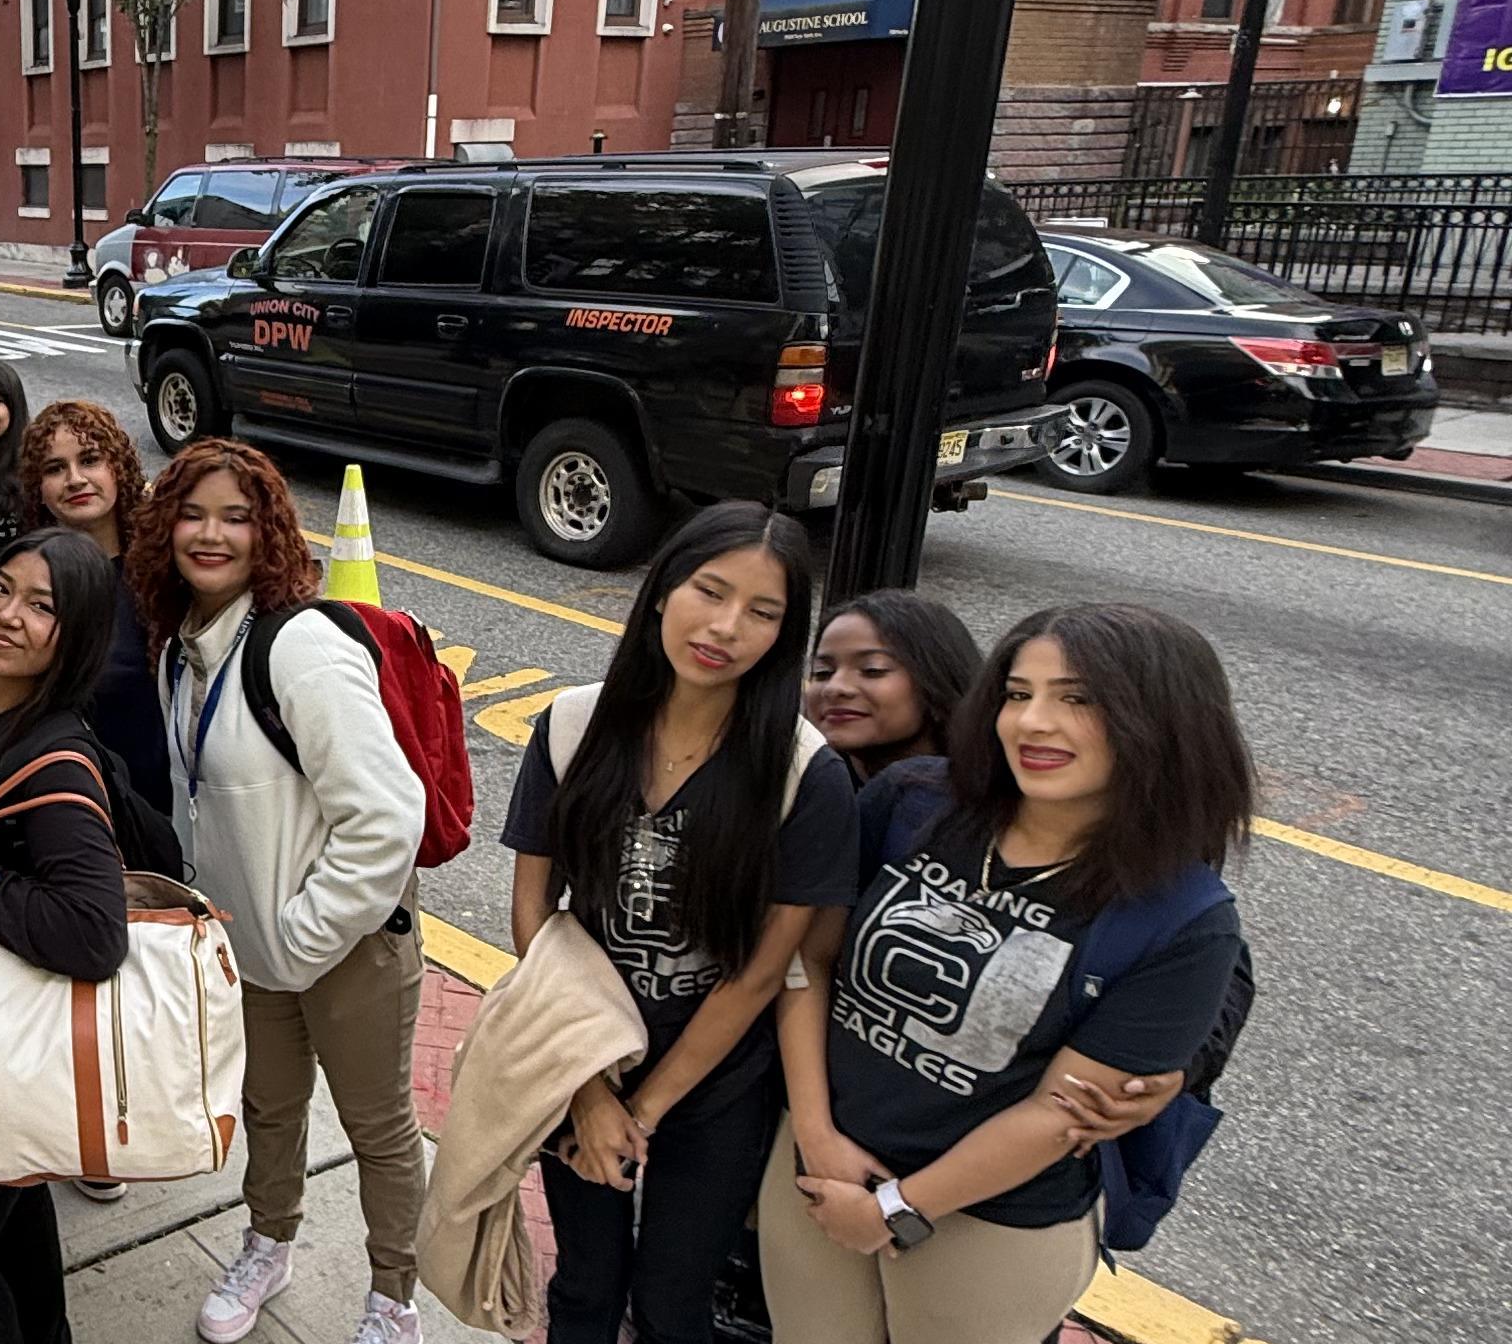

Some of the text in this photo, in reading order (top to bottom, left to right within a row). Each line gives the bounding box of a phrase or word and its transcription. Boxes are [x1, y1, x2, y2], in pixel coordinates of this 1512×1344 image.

[759, 11, 869, 34] AUGUSTINE SCHOOL
[249, 299, 322, 323] UNION CITY
[565, 308, 673, 336] INSPECTOR
[253, 319, 314, 352] DPW
[831, 998, 978, 1097] EAGLES
